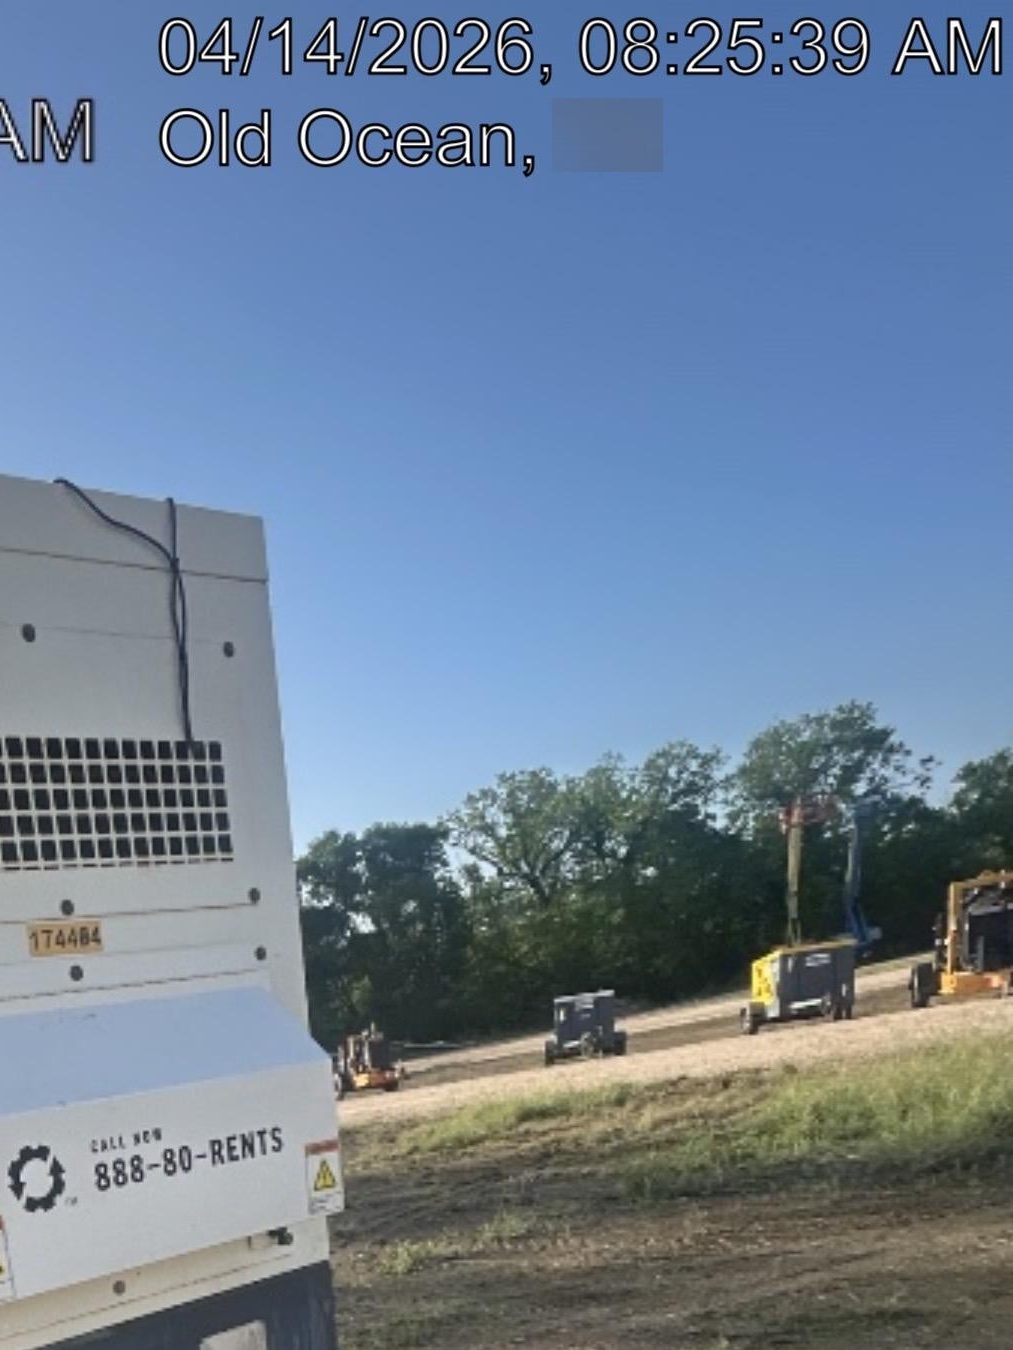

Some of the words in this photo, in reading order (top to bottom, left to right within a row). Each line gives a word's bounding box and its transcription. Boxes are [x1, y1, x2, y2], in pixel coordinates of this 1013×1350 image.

[91, 1133, 126, 1153] CALL
[132, 1126, 162, 1147] NOW
[94, 1126, 284, 1192] 888-80-RENTS
